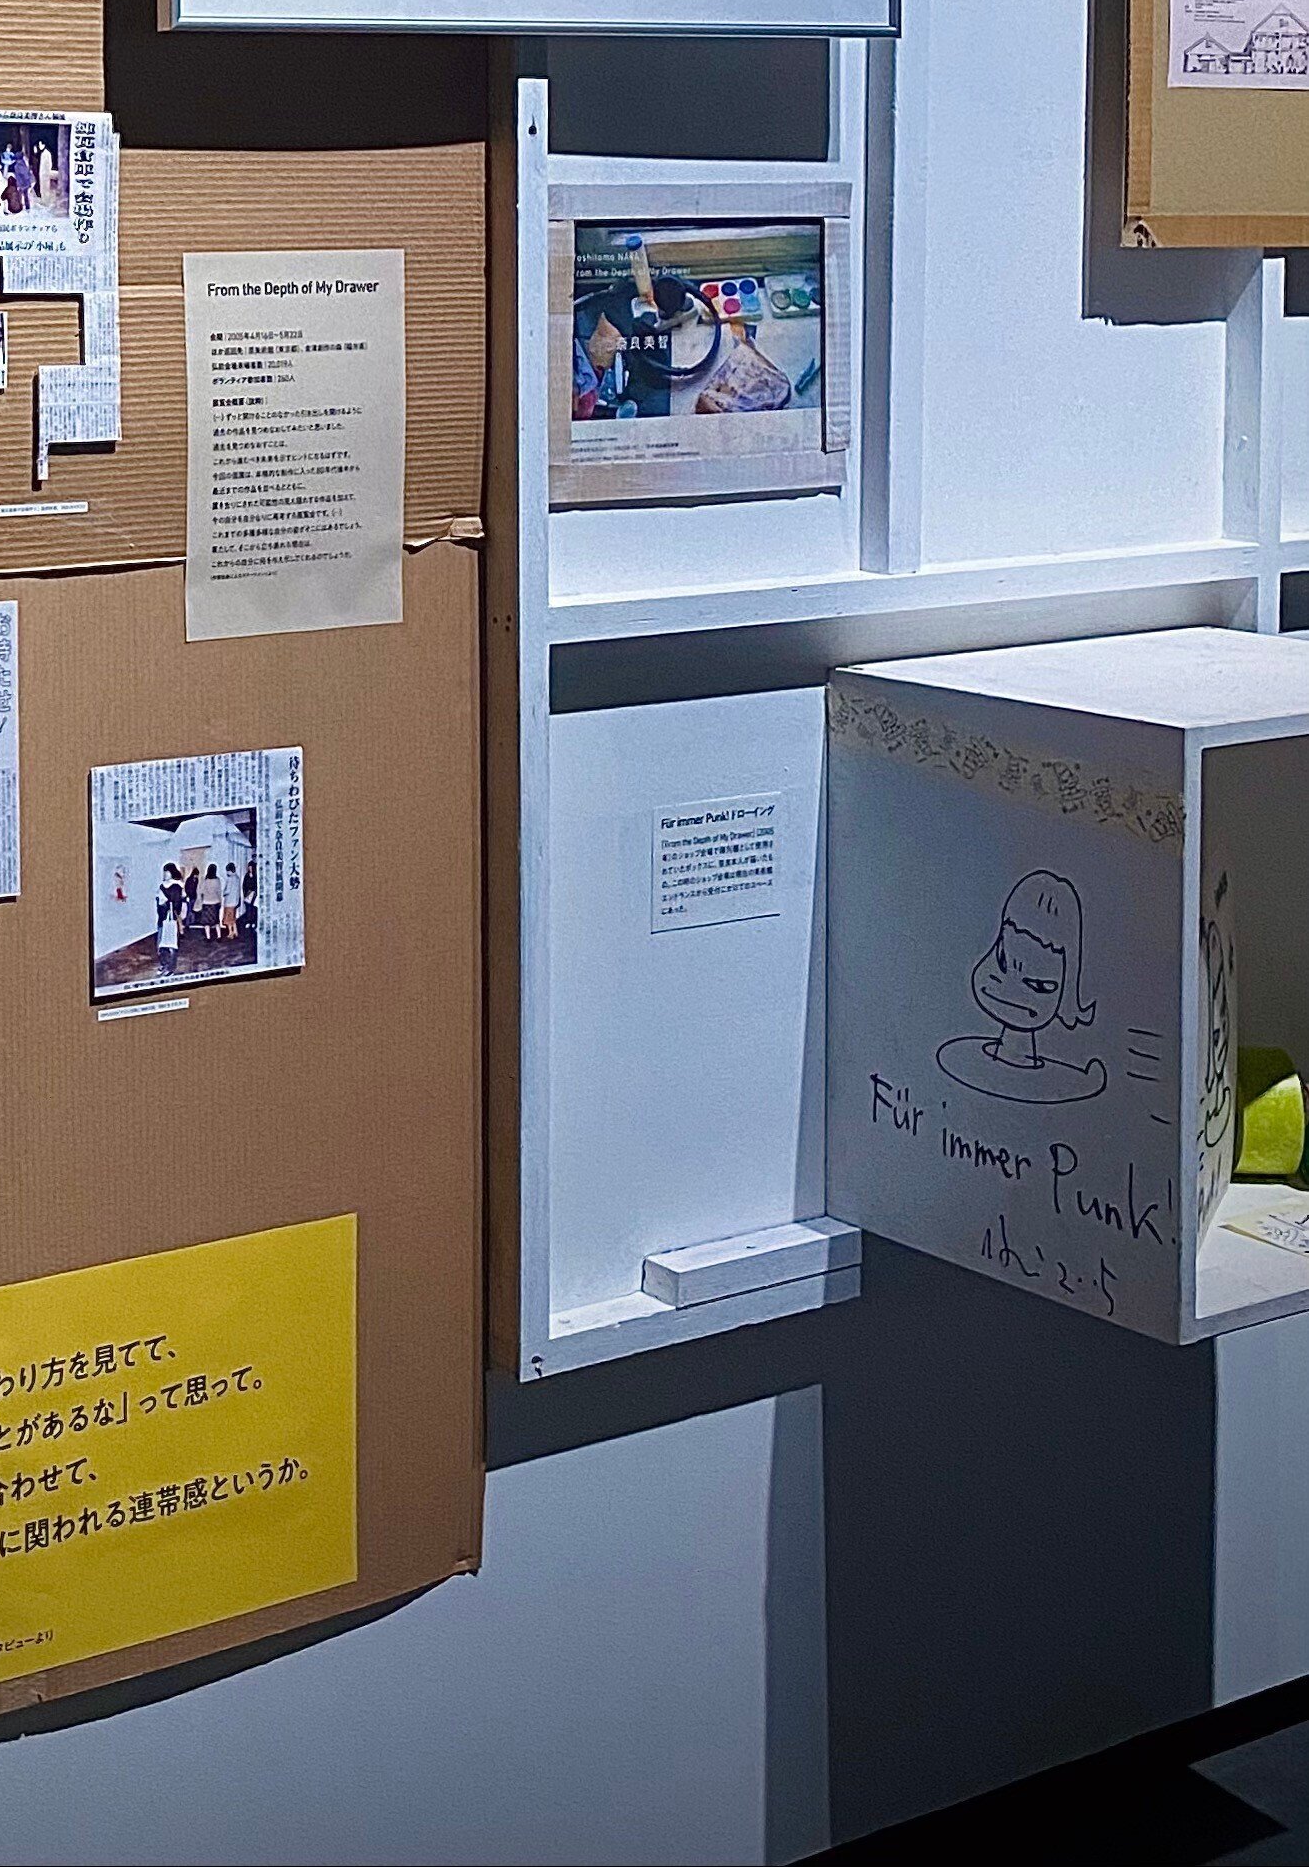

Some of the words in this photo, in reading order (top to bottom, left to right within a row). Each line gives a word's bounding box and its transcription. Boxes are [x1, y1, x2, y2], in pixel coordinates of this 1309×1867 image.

[207, 283, 240, 297] From
[242, 282, 261, 296] the
[264, 281, 298, 297] Depth
[301, 280, 312, 294] of
[316, 280, 332, 296] My
[335, 280, 379, 295] Drawer
[732, 805, 775, 821] ドローイング
[870, 1074, 923, 1135] Für
[941, 1102, 1031, 1180] immer
[1049, 1142, 1179, 1245] Punk!
